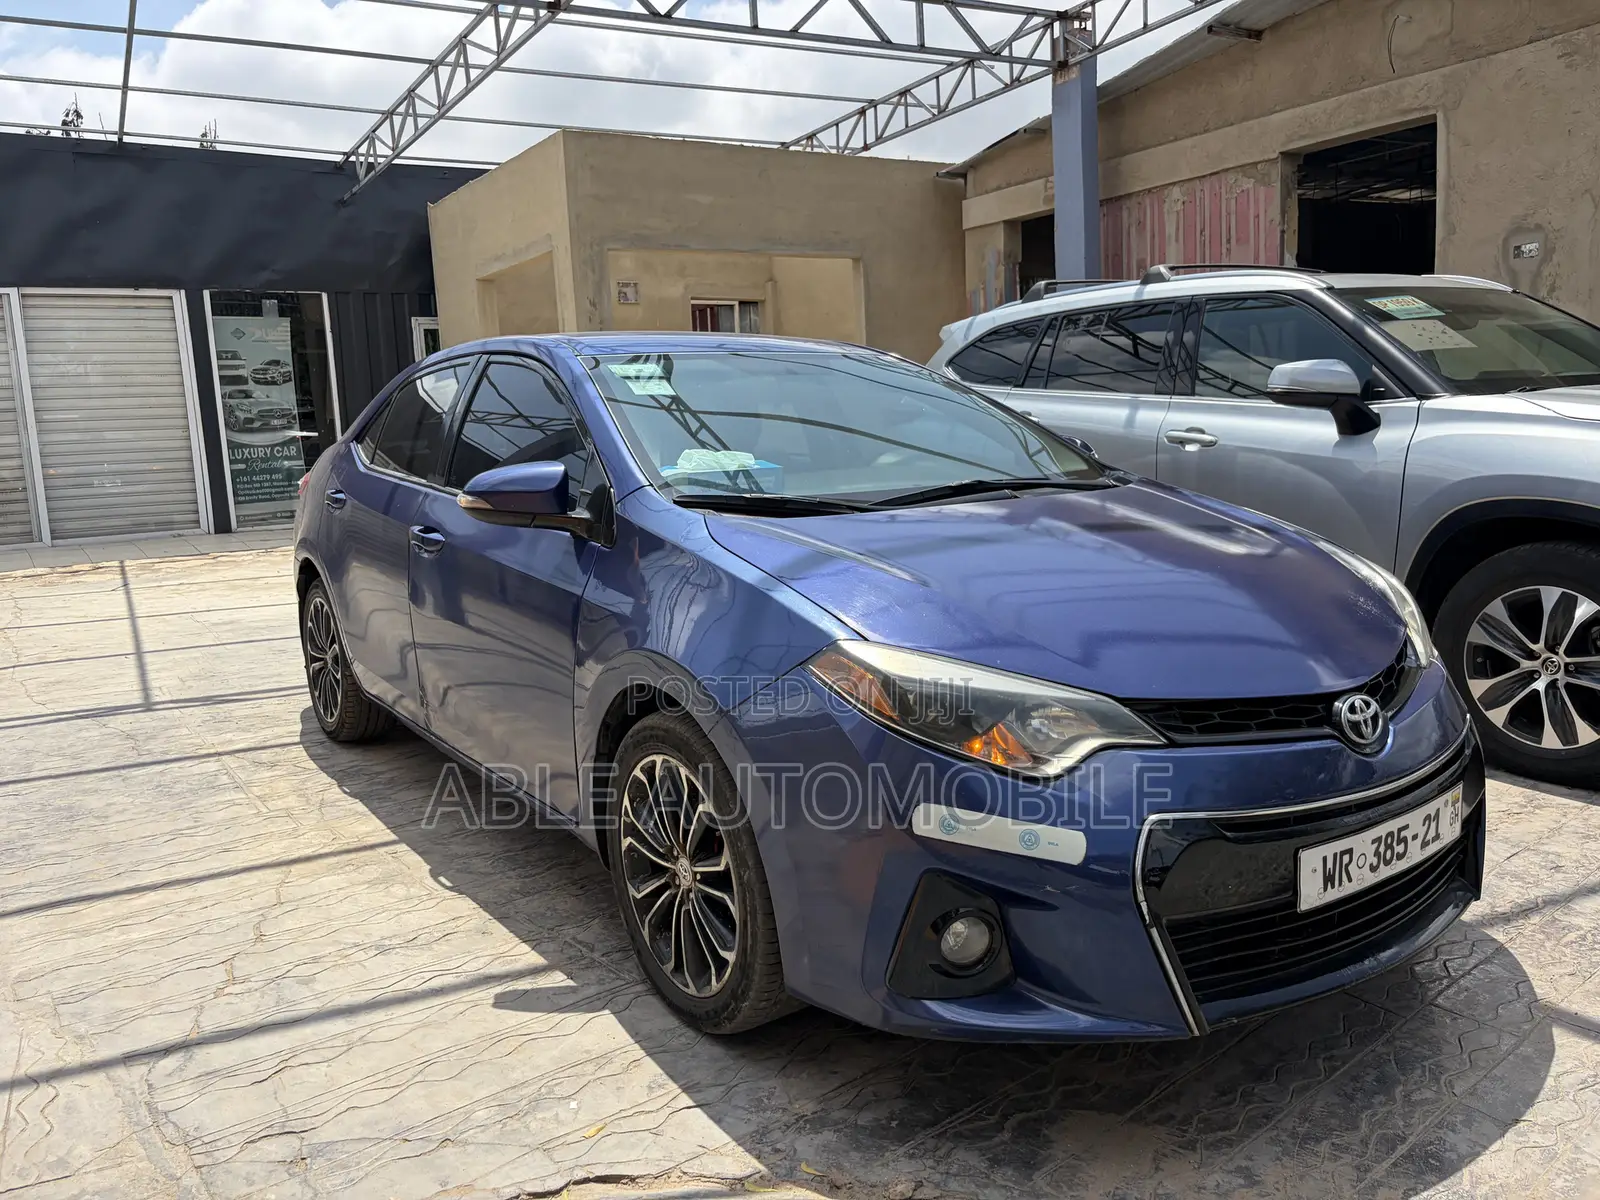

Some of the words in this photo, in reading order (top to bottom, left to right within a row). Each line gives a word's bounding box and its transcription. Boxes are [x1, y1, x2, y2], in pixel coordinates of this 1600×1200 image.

[229, 446, 272, 460] LUXURY
[274, 445, 297, 457] CAR
[247, 459, 282, 471] Rental
[1449, 805, 1459, 828] GH
[1322, 847, 1354, 893] WR
[1369, 807, 1441, 874] 385-21
